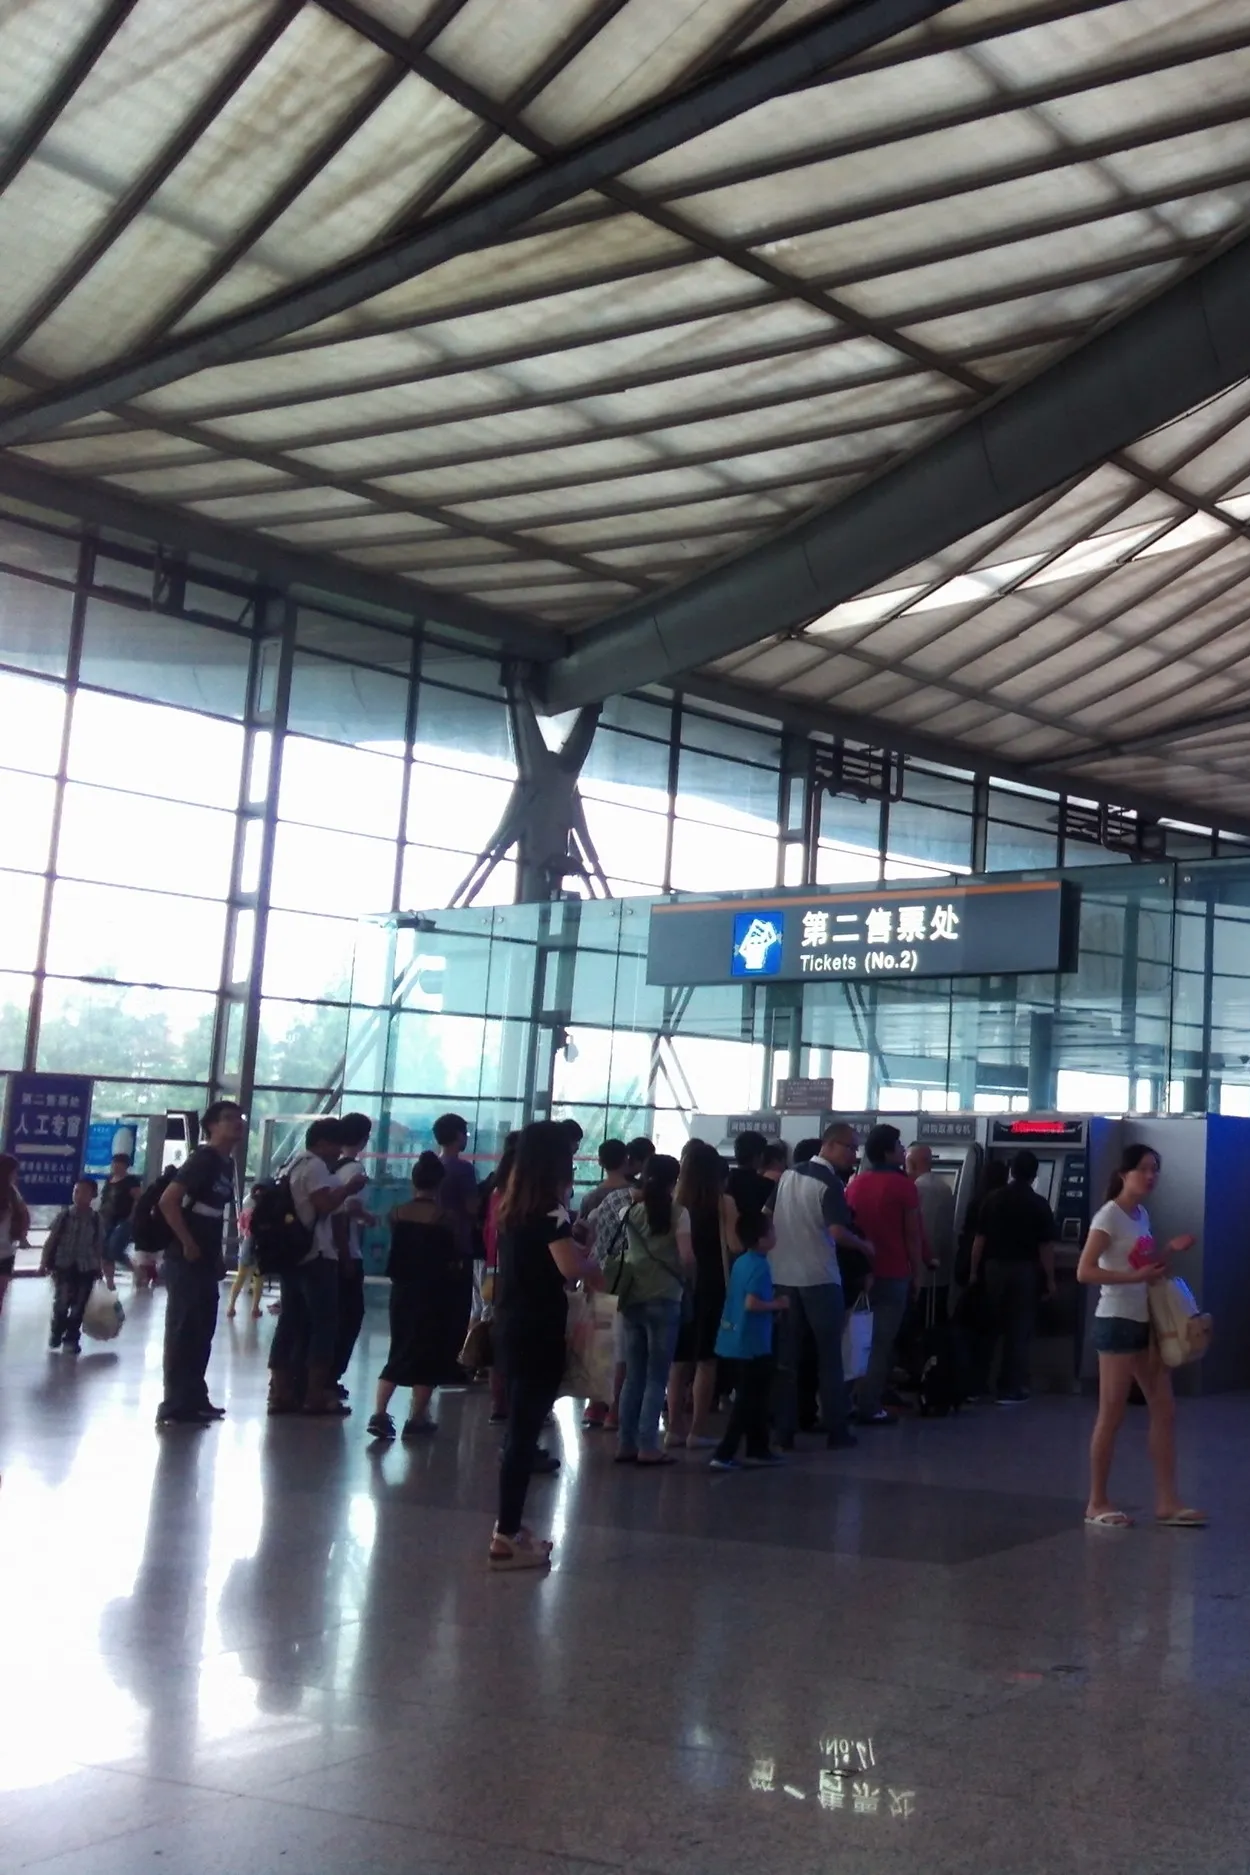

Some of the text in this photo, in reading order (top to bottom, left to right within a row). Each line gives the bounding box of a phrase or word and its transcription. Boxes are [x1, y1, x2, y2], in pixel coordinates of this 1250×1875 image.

[801, 903, 960, 947] 第二售票处
[800, 950, 918, 973] Tickets (No.2)
[14, 1112, 82, 1138] 人工专窗
